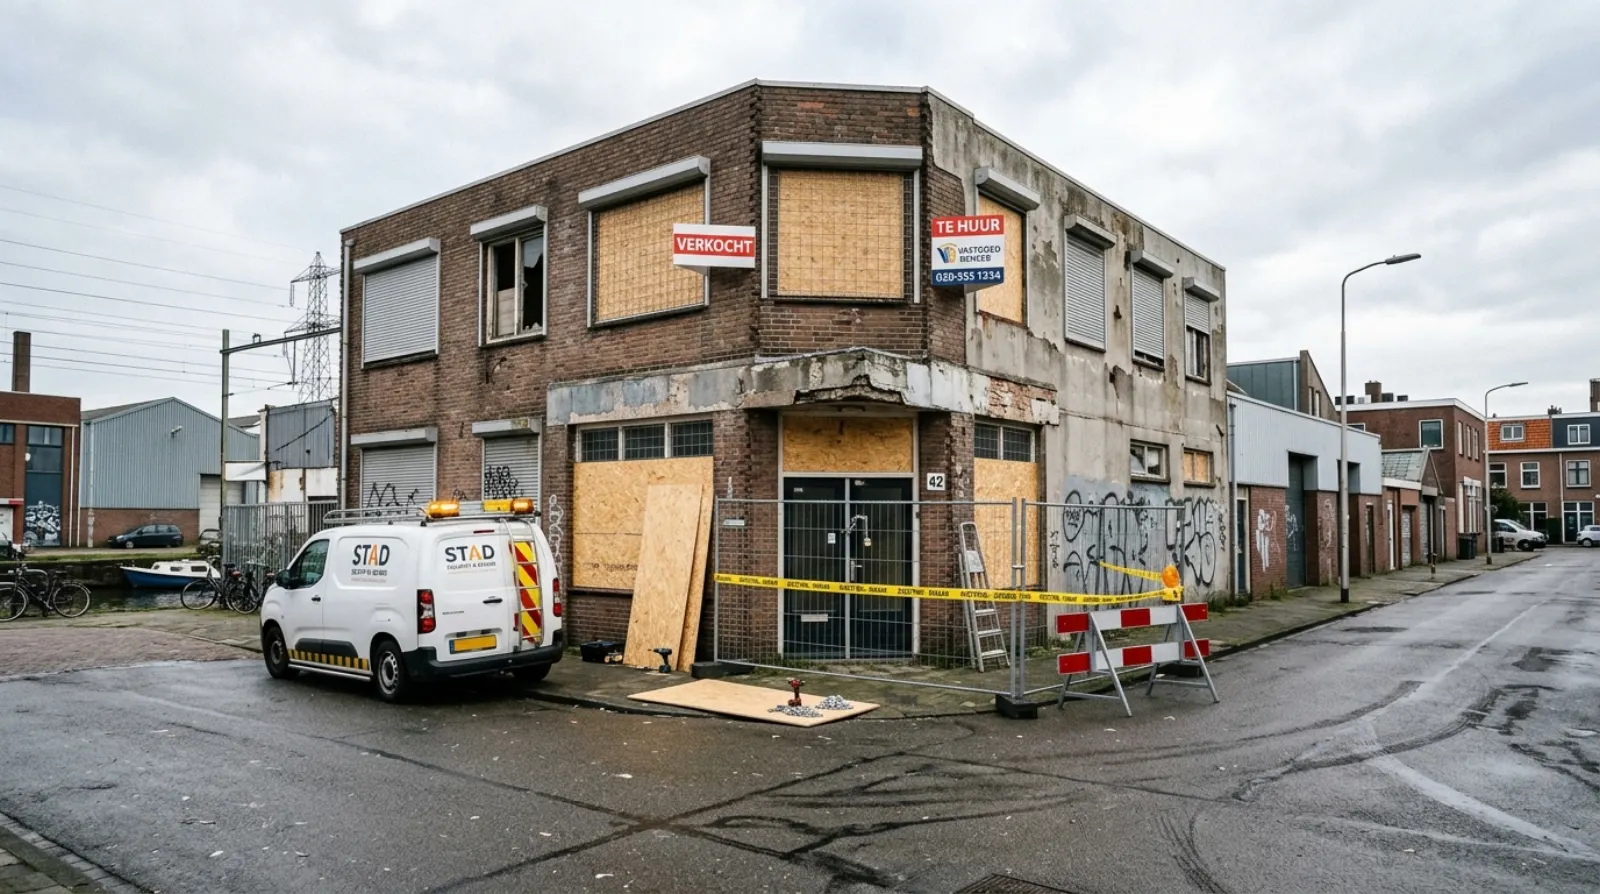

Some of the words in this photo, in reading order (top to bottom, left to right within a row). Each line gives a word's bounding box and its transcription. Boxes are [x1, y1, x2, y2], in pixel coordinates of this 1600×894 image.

[936, 220, 954, 234] TE
[957, 218, 1000, 233] HUUR
[676, 237, 753, 254] VERKOCHT
[977, 270, 1001, 280] 1234
[929, 475, 943, 488] 42
[352, 544, 390, 567] STAD
[445, 544, 495, 562] STAD
